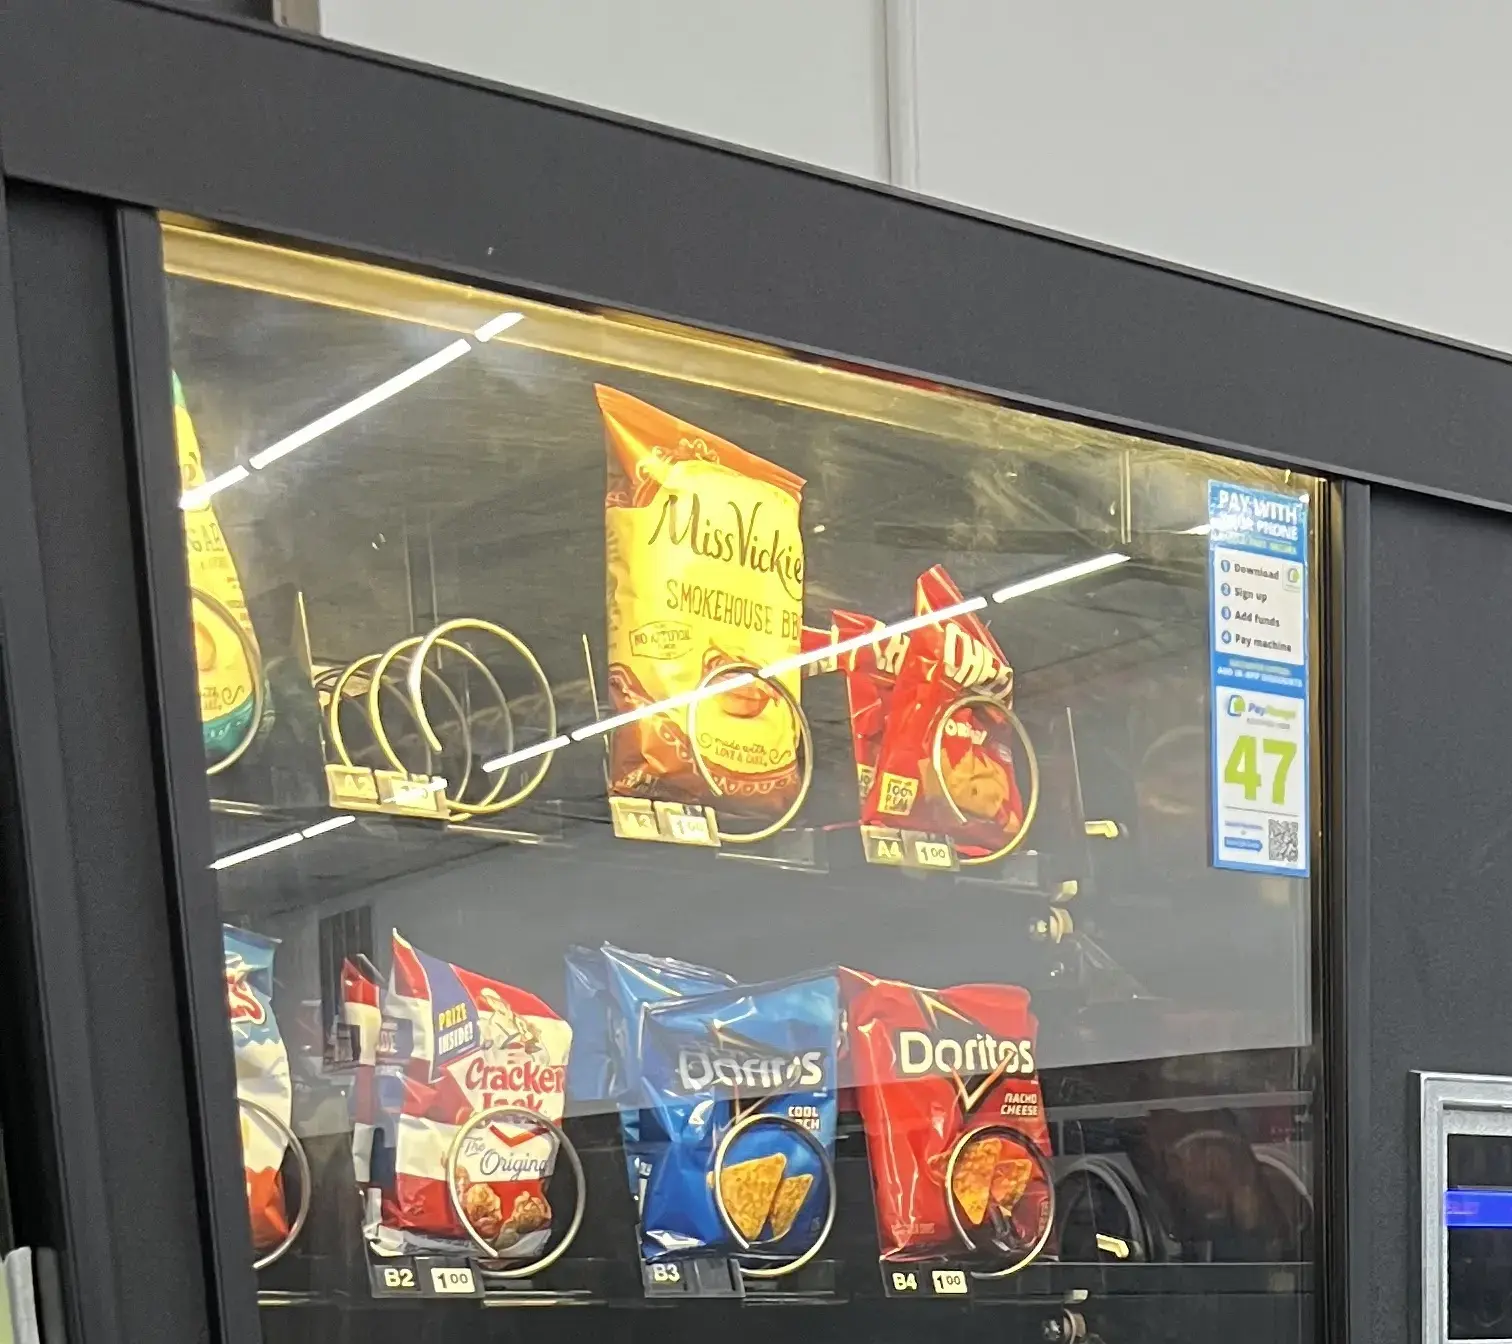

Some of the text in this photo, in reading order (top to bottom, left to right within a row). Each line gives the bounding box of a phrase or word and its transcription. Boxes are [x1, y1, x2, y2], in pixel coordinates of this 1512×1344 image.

[1219, 490, 1250, 513] PAY
[1253, 498, 1297, 524] WITH
[648, 493, 733, 562] Miss
[1256, 520, 1298, 540] PHONE
[1234, 563, 1280, 580] Download
[1234, 587, 1254, 601] Sign
[1256, 590, 1268, 604] up
[666, 578, 774, 635] SMOKEHOUSE
[1234, 610, 1281, 628] Add funds
[1235, 633, 1252, 648] Pay
[1253, 638, 1292, 652] machine
[1223, 734, 1298, 806] 47
[438, 1002, 468, 1032] PRIZE
[438, 1023, 474, 1056] INSIDE!
[899, 1030, 1036, 1075] Doritos
[466, 1060, 565, 1093] Cracker
[1003, 1091, 1038, 1105] NACHO
[787, 1105, 819, 1120] COOL
[1000, 1104, 1039, 1117] CHEESE
[463, 1134, 486, 1159] The
[384, 1268, 415, 1288] B2
[653, 1263, 680, 1282] B3
[893, 1273, 918, 1291] B4
